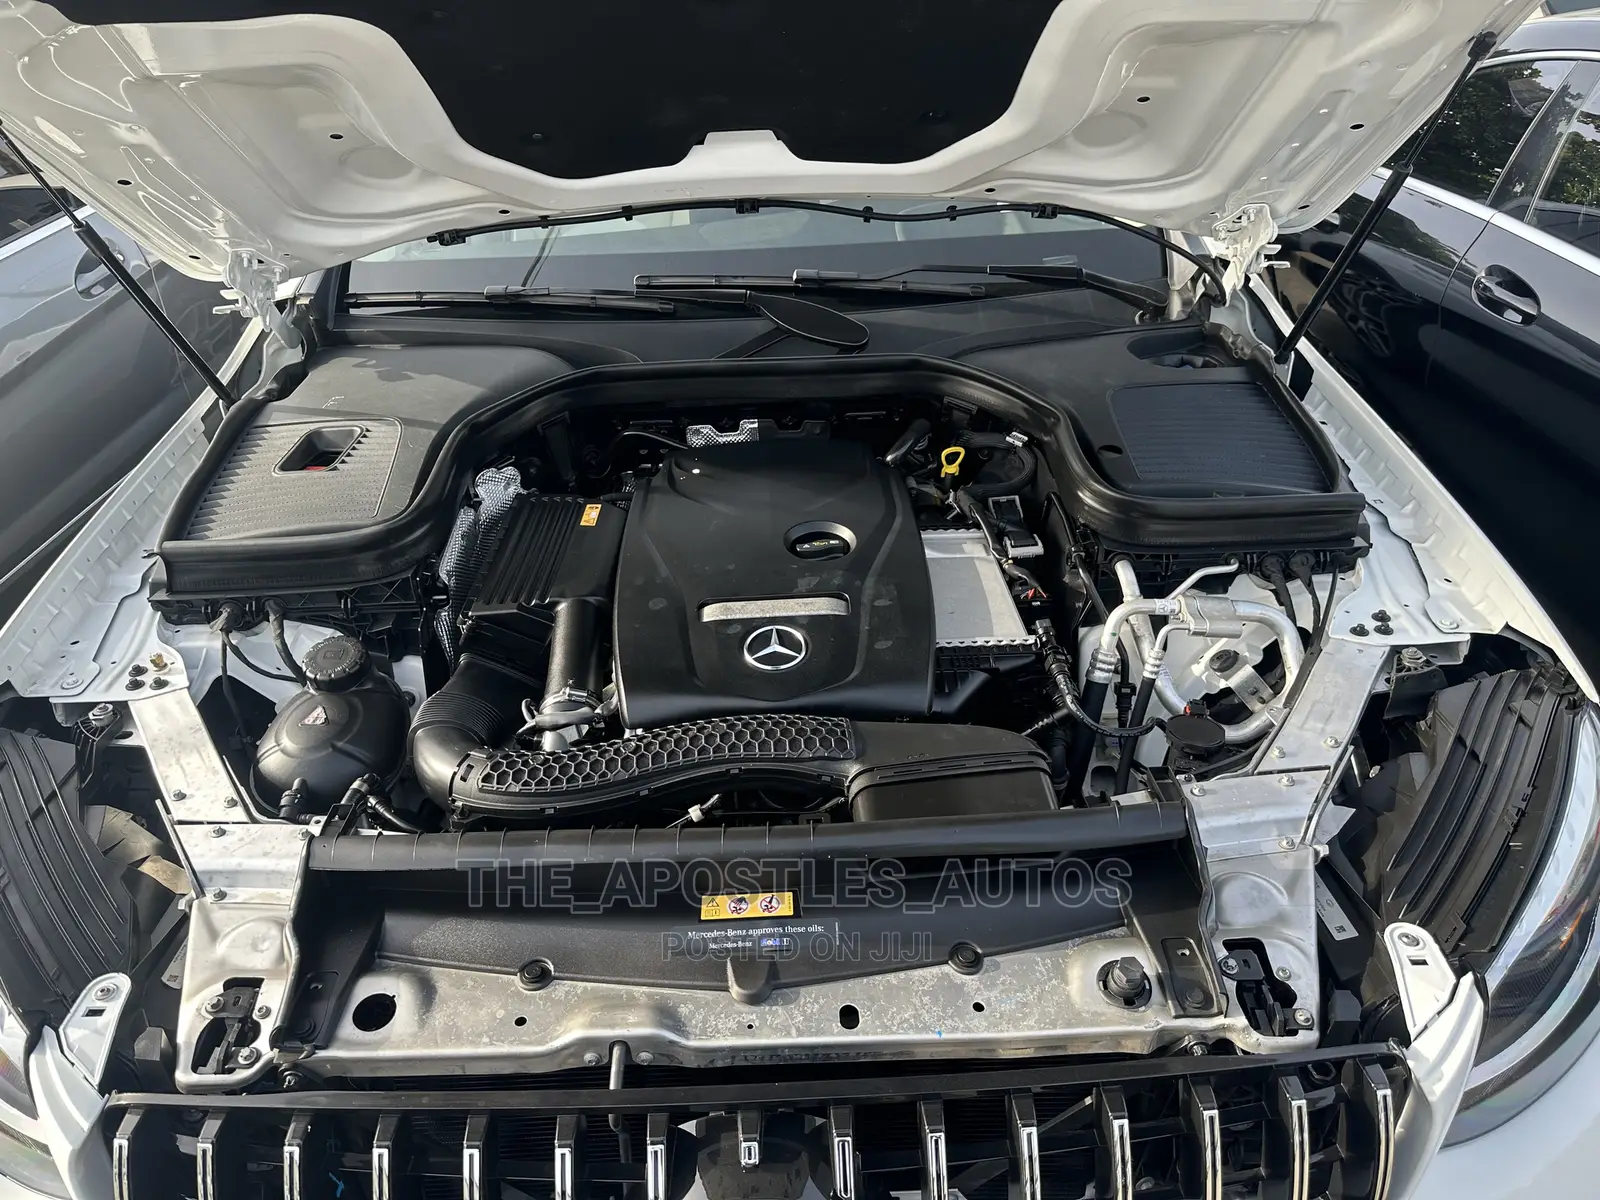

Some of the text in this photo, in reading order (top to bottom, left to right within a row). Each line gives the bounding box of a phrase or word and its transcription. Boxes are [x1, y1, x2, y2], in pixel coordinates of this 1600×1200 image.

[687, 924, 825, 940] Mercedes-Benz approves these oils:
